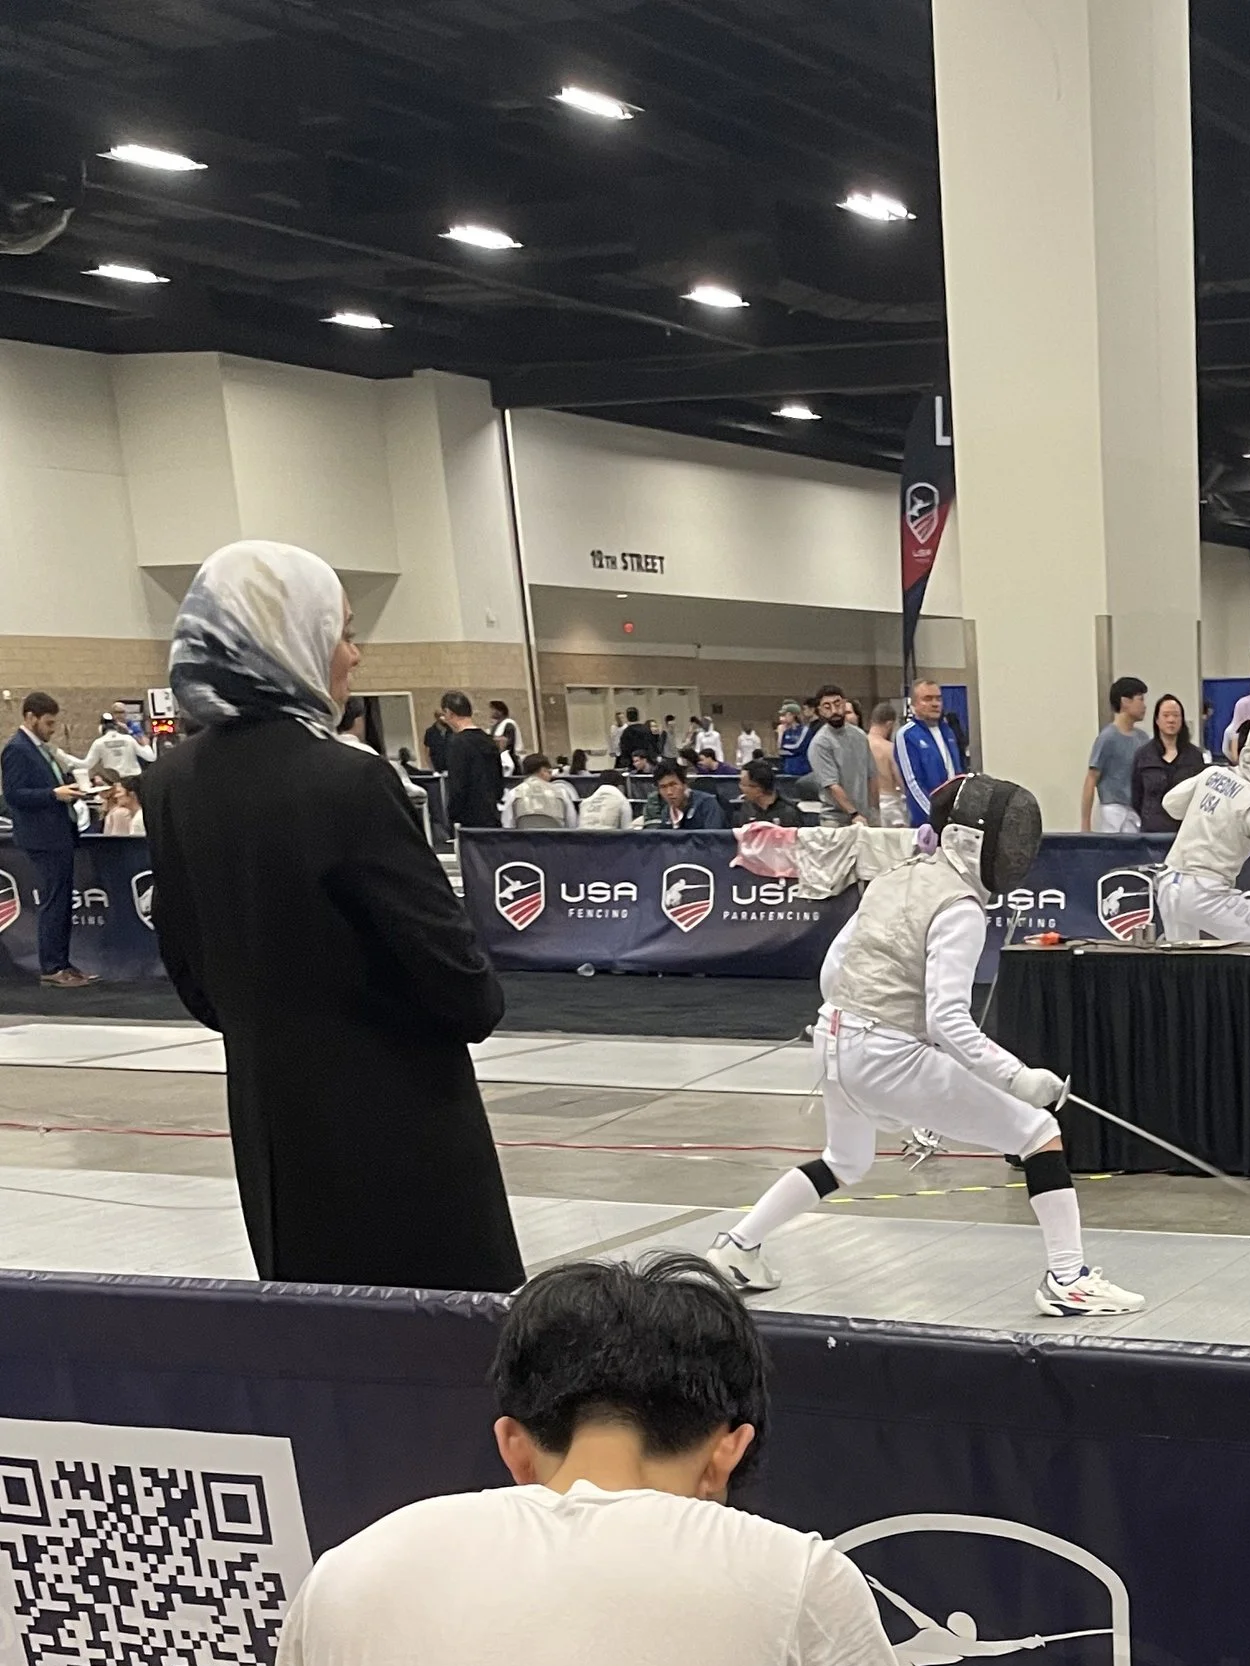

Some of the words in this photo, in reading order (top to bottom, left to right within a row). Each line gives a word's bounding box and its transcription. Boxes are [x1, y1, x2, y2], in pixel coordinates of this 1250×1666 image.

[621, 552, 664, 575] STREET
[1200, 792, 1221, 815] USA
[561, 881, 638, 902] USA
[567, 908, 629, 919] FENCING
[723, 911, 821, 921] PARAFENCING
